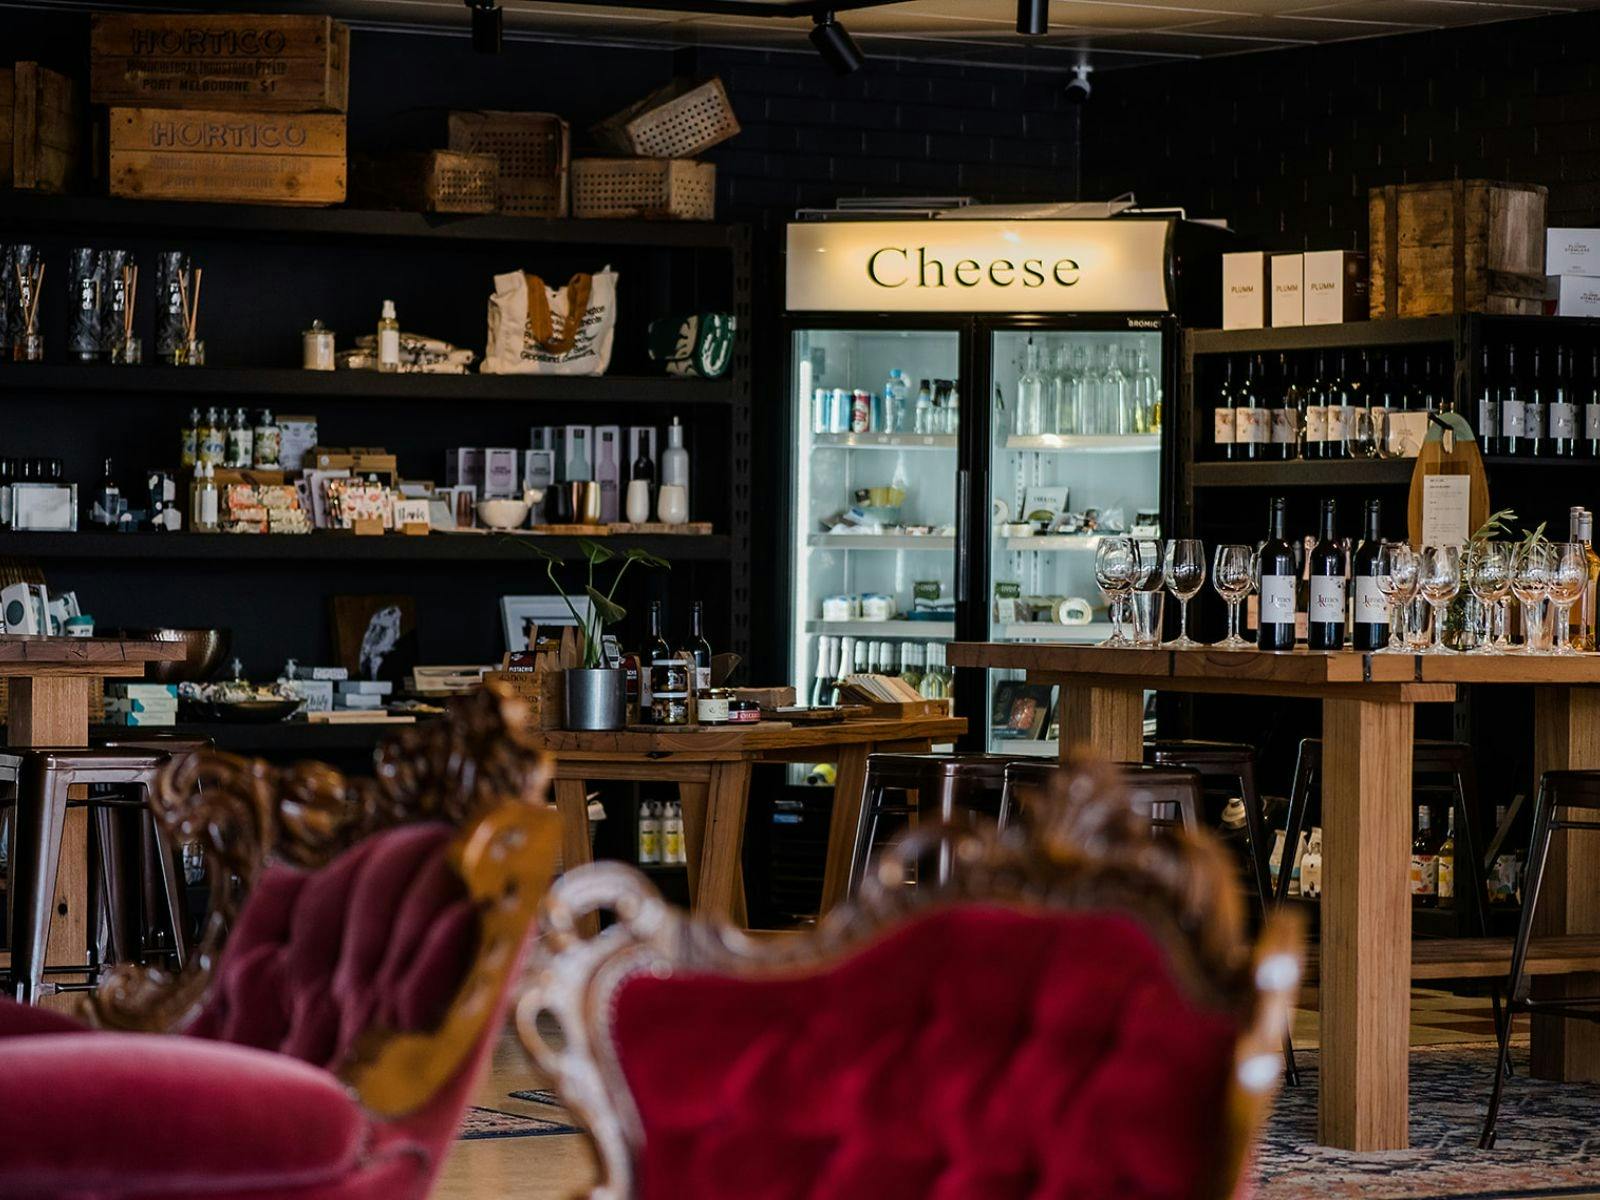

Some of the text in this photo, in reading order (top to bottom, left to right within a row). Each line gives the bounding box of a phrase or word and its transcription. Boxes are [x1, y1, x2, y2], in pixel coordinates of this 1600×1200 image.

[131, 28, 287, 54] HORTICO
[142, 79, 171, 91] PORT
[179, 79, 250, 92] MELBOURNE
[151, 121, 308, 148] HORTICO
[866, 245, 1081, 289] Cheese
[1230, 284, 1255, 294] PLUMM
[1275, 284, 1299, 294] PLUMM
[1310, 281, 1336, 294] PLUMM
[1128, 319, 1160, 330] BROMIC
